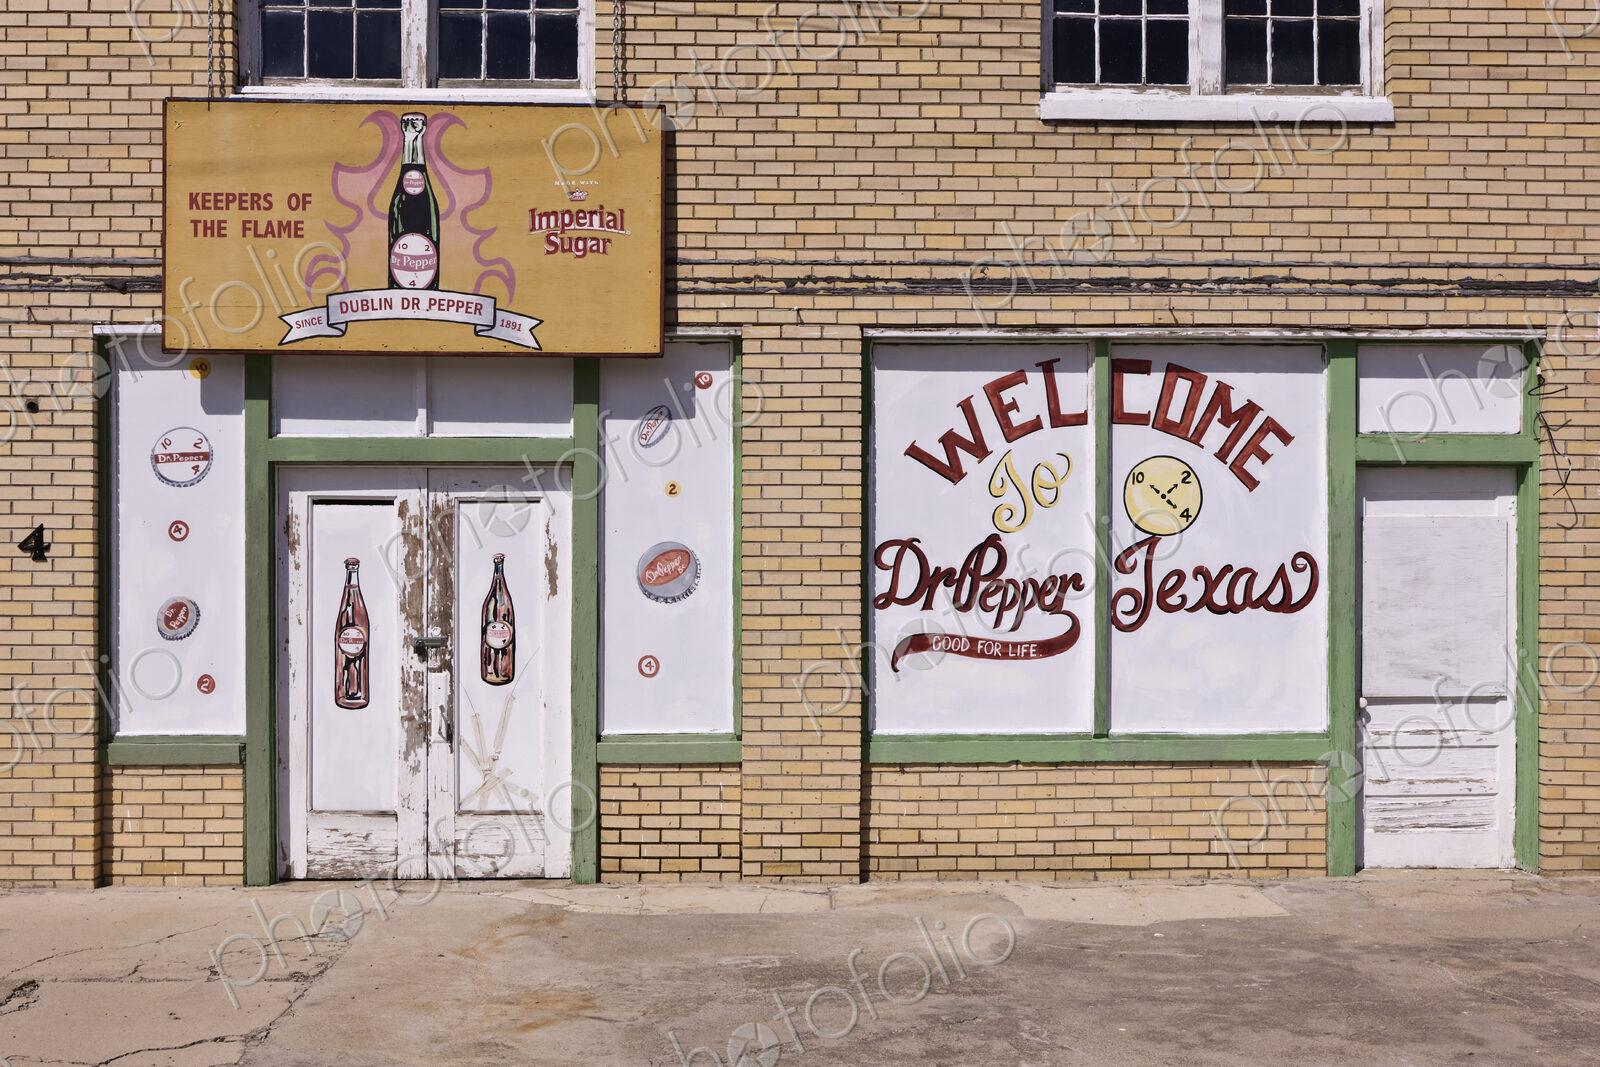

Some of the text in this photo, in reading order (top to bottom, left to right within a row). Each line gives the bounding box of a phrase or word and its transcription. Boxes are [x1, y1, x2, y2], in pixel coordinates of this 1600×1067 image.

[189, 192, 312, 211] KEEPERS OF
[528, 204, 625, 234] Imperial
[190, 219, 304, 238] THE FLAME
[424, 244, 431, 252] 2
[544, 232, 612, 258] Sugar
[391, 255, 437, 270] Dr Pepper
[408, 279, 417, 288] 4
[295, 297, 523, 332] SINCE DUBLIN DR PEPPER 1891
[195, 362, 208, 375] 10
[699, 374, 710, 386] 10
[161, 438, 204, 450] 10 2
[191, 464, 200, 476] 4
[1132, 470, 1192, 486] 10 2
[668, 483, 678, 495] 2
[988, 448, 1074, 533] To
[1179, 507, 1193, 523] 4
[172, 524, 183, 536] 4
[17, 523, 51, 562] 4
[1111, 535, 1319, 632] Texas
[931, 635, 1043, 657] GOOD FOR LIFE.
[644, 660, 654, 672] 4
[200, 678, 210, 692] 2
